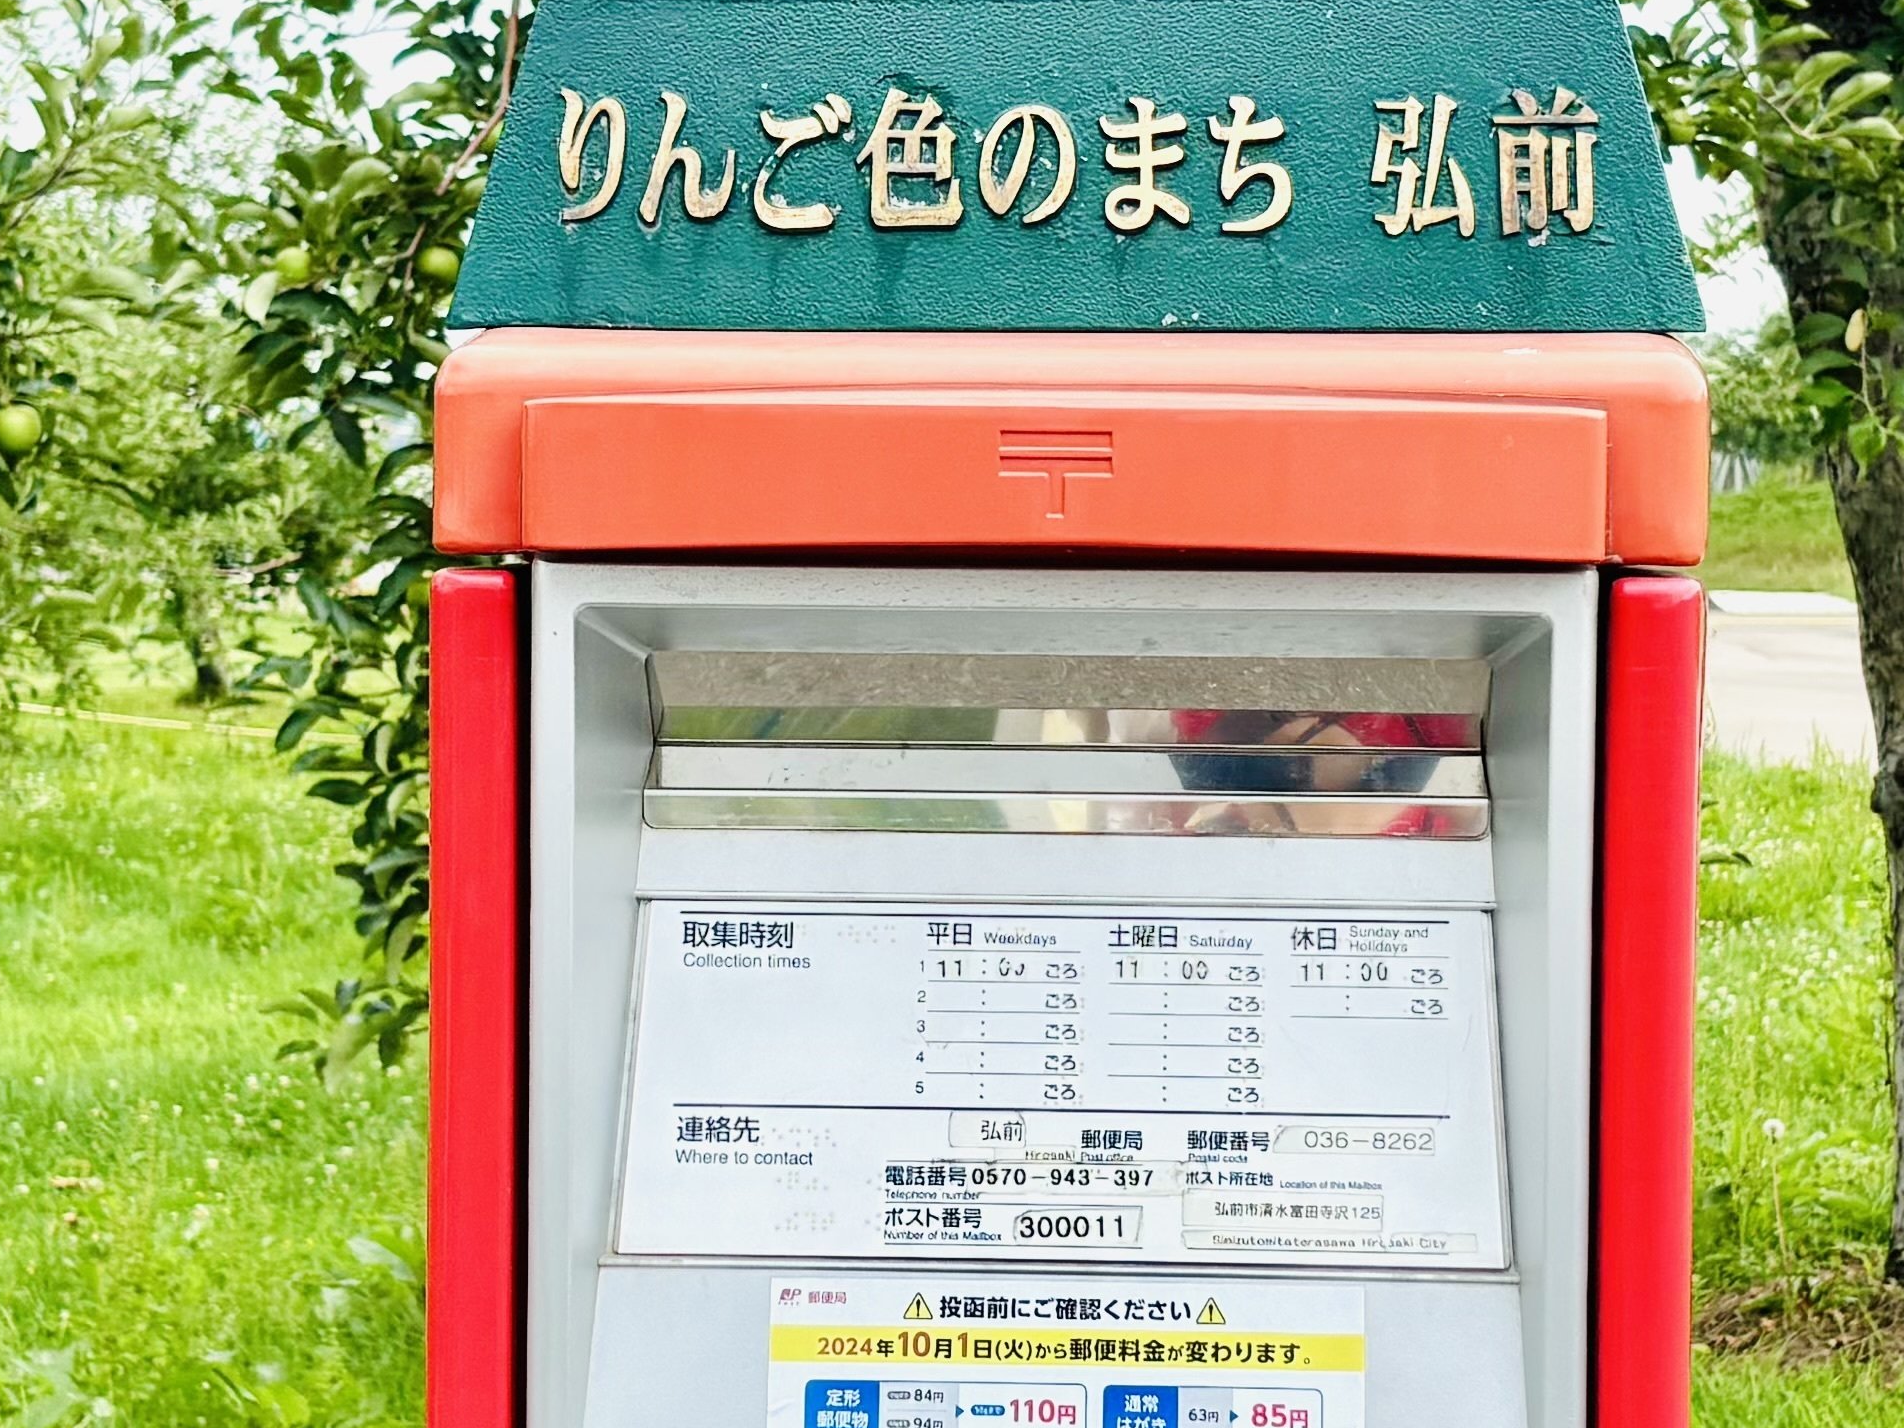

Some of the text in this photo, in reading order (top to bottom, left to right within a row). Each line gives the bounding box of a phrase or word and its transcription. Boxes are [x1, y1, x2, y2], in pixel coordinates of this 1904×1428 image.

[556, 84, 1600, 238] りんご色のまち 弘前
[682, 921, 794, 949] 取集時刻
[926, 922, 1057, 947] 平日 Weekdays
[1108, 924, 1253, 950] 土曜日 Saturday
[1290, 926, 1337, 951] 休日
[1349, 925, 1429, 941] Sunday and
[1349, 941, 1408, 955] Holidays
[683, 952, 811, 969] Collection times
[1228, 966, 1261, 982] ごろ
[1410, 968, 1444, 985] ごろ
[916, 990, 927, 1004] 2
[916, 1020, 926, 1034] 3
[915, 1050, 925, 1063] 4
[914, 1081, 925, 1095] 5
[676, 1116, 760, 1143] 連絡先
[980, 1120, 1024, 1143] 弘前
[1080, 1129, 1143, 1151] 郵便局
[1187, 1130, 1433, 1152] 郵便番号 036-8262
[675, 1149, 813, 1166] Where to contact
[885, 1165, 1155, 1188] 電話番号 0570-943-397
[1185, 1171, 1274, 1187] ポスト所在地
[884, 1207, 1124, 1239] ポスト番号 300011
[927, 1230, 939, 1241] of
[1419, 1238, 1446, 1250] City
[938, 1295, 1192, 1321] 投函前にご確認ください
[816, 1330, 1311, 1366] 2024年10月1日(火)から郵便料金が変わります。
[825, 1389, 860, 1409] 定形
[913, 1388, 945, 1404] 84円
[1124, 1394, 1159, 1414] 通常
[1010, 1398, 1077, 1425] 110円
[1188, 1408, 1220, 1423] 63円
